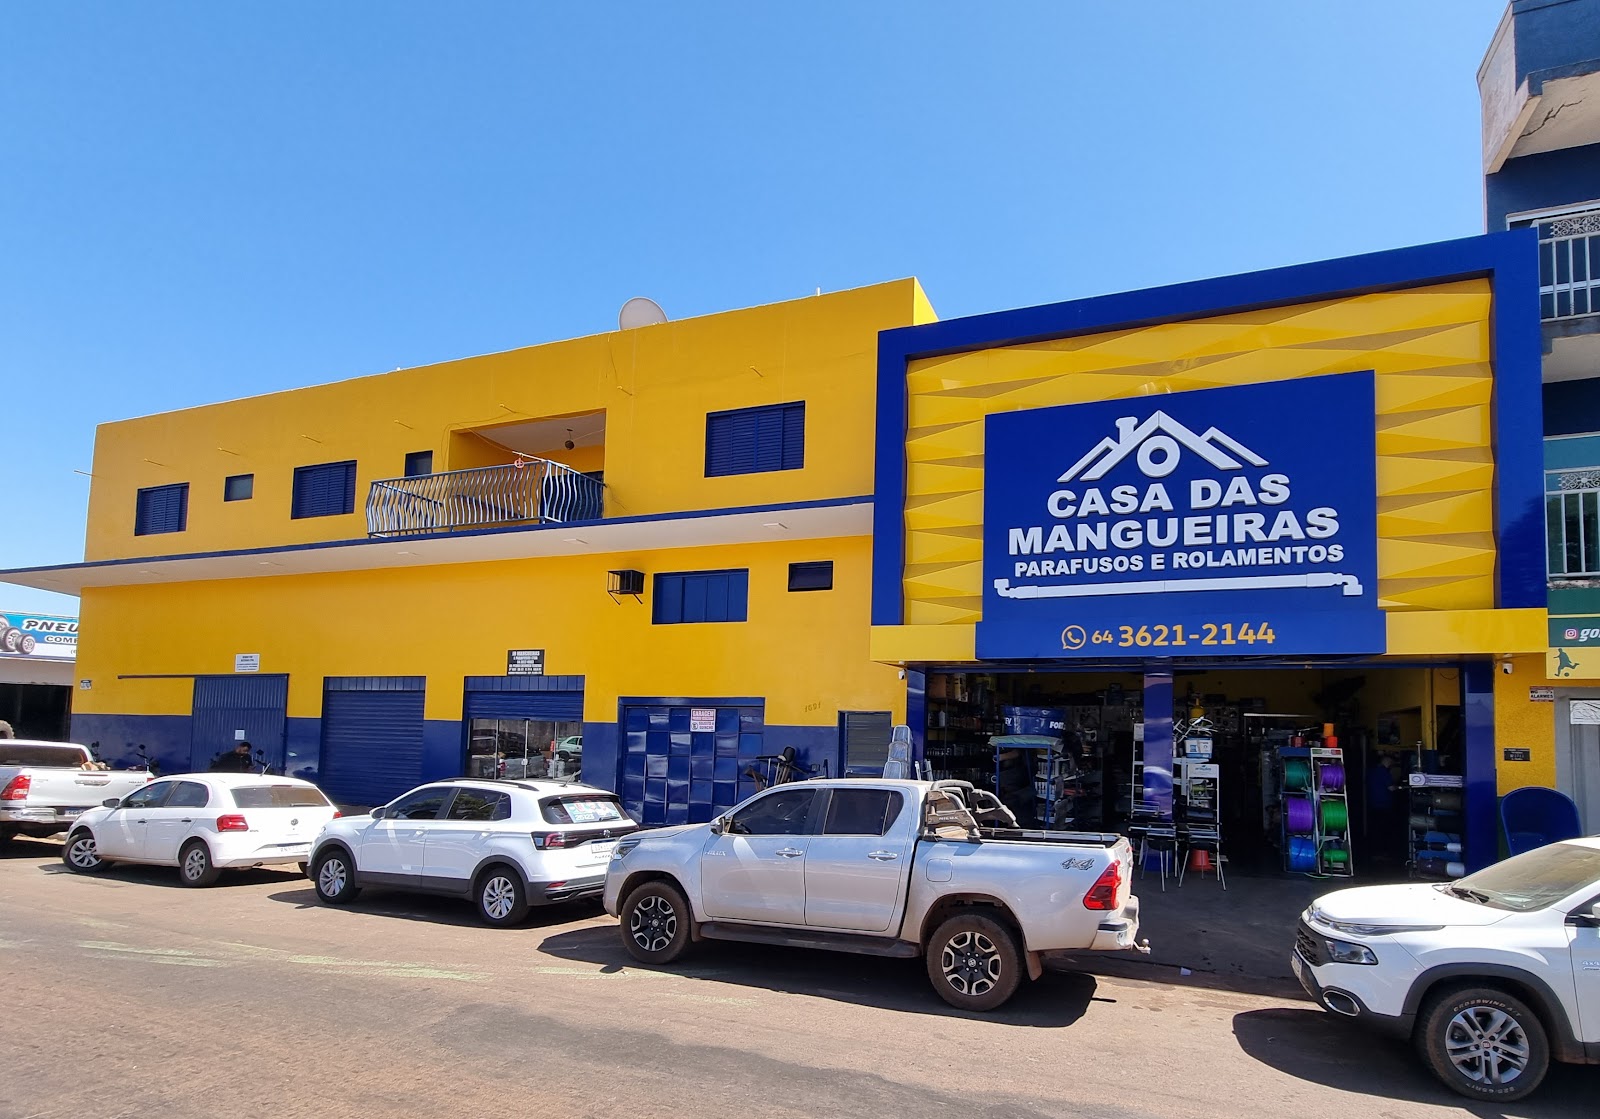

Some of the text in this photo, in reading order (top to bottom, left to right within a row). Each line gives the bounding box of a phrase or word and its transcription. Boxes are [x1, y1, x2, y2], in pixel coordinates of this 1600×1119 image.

[1047, 473, 1290, 518] CASA DAS
[1008, 507, 1340, 555] MANGUEIRAS
[1014, 544, 1344, 577] PARAFUSOS E ROLAMENTOS
[1091, 622, 1276, 647] 64 3621-2144
[1453, 998, 1506, 1013] CROSSWIND
